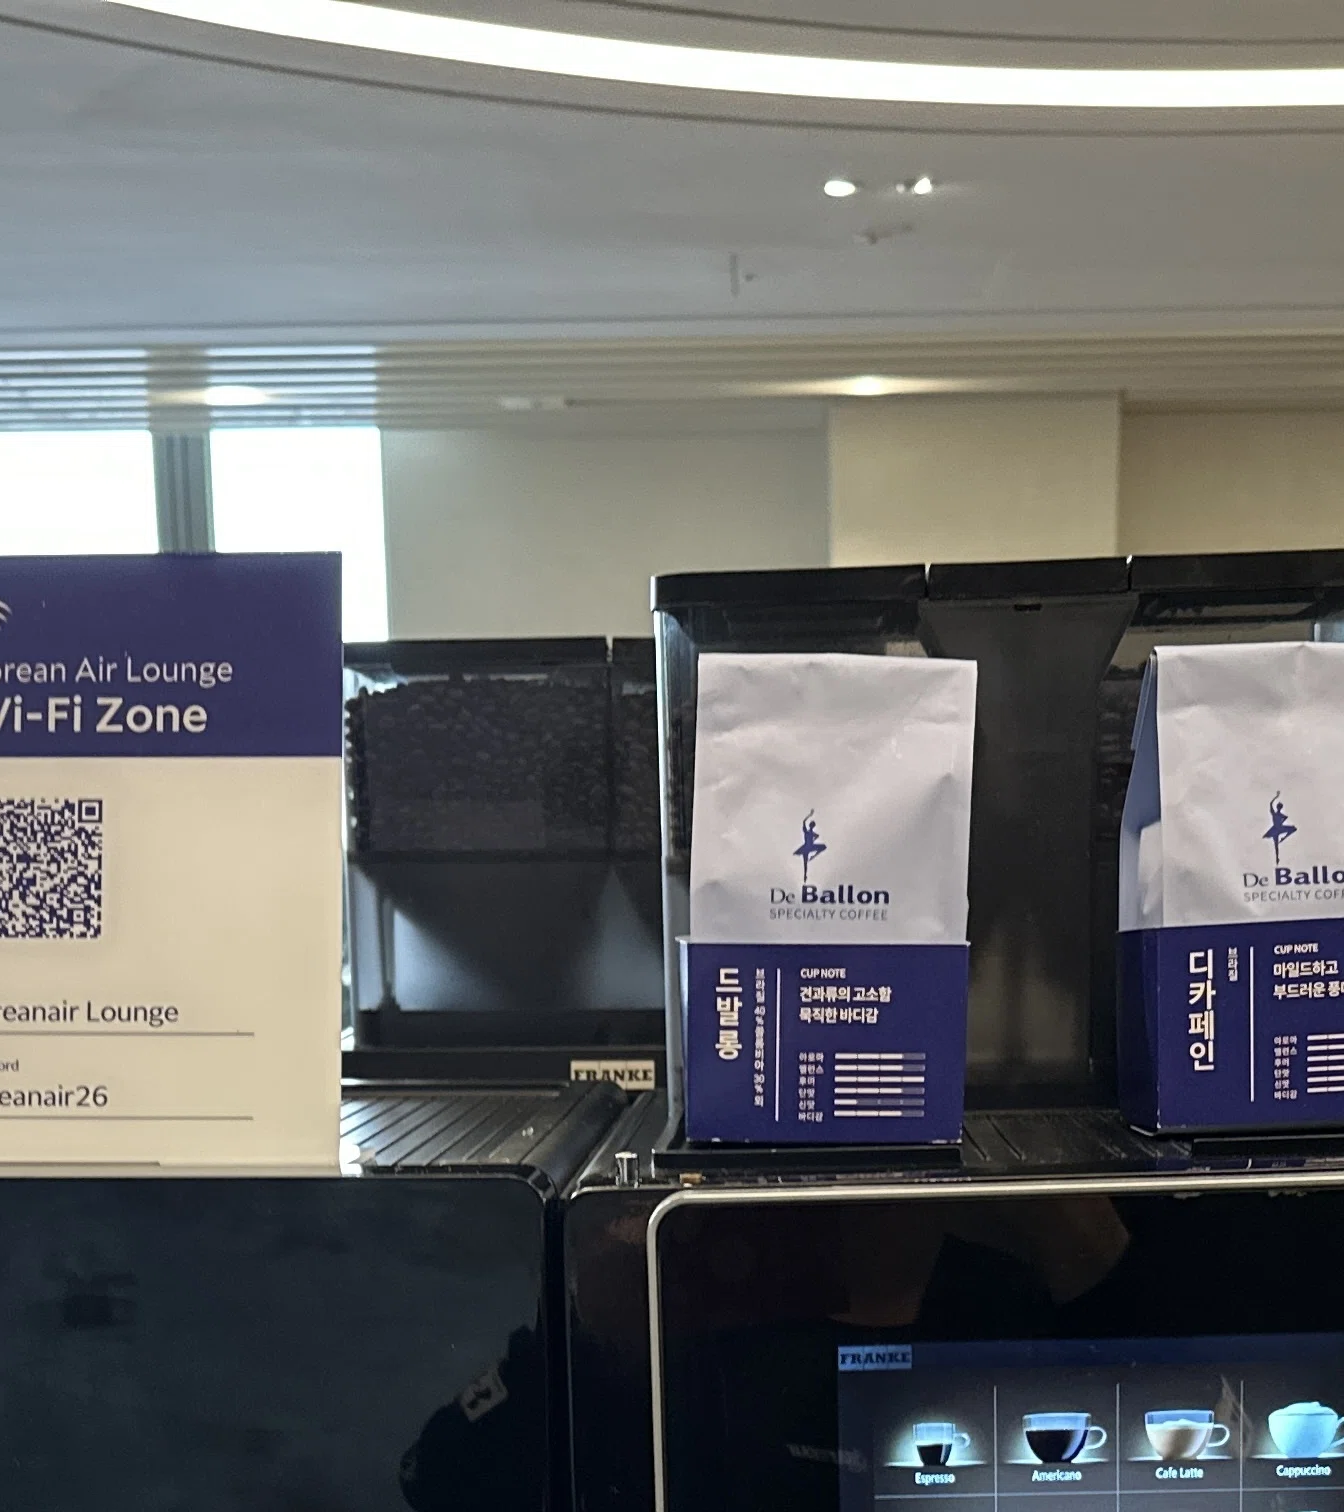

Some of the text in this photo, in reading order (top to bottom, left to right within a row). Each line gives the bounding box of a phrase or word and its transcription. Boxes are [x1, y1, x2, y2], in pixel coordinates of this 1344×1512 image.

[75, 657, 118, 682] Air
[127, 657, 233, 689] Lounge
[96, 697, 208, 734] Zone
[1243, 872, 1269, 888] De
[770, 885, 890, 905] De Ballon
[1243, 889, 1311, 902] SPECIALTY
[769, 908, 888, 920] SPECIALTY COFFEE
[1273, 943, 1319, 955] CUP NOTE
[1228, 947, 1239, 982] 브라질
[1273, 960, 1339, 979] 마일드하고
[800, 968, 846, 979] CUP NOTE
[800, 986, 892, 1003] 견과류의 고소함
[1273, 982, 1326, 1000] 부드러운
[86, 1000, 179, 1027] Lounge
[715, 968, 743, 1060] 드발롱
[799, 1007, 879, 1024] 묵직한 바디감
[1188, 948, 1217, 1071] 디카페인
[573, 1069, 653, 1082] FRANKE
[840, 1350, 912, 1368] FRANKE
[914, 1471, 955, 1486] Espresso
[1032, 1469, 1082, 1482] Americano
[1155, 1466, 1204, 1479] Cafe Latte
[1276, 1464, 1331, 1478] Cappuccino
